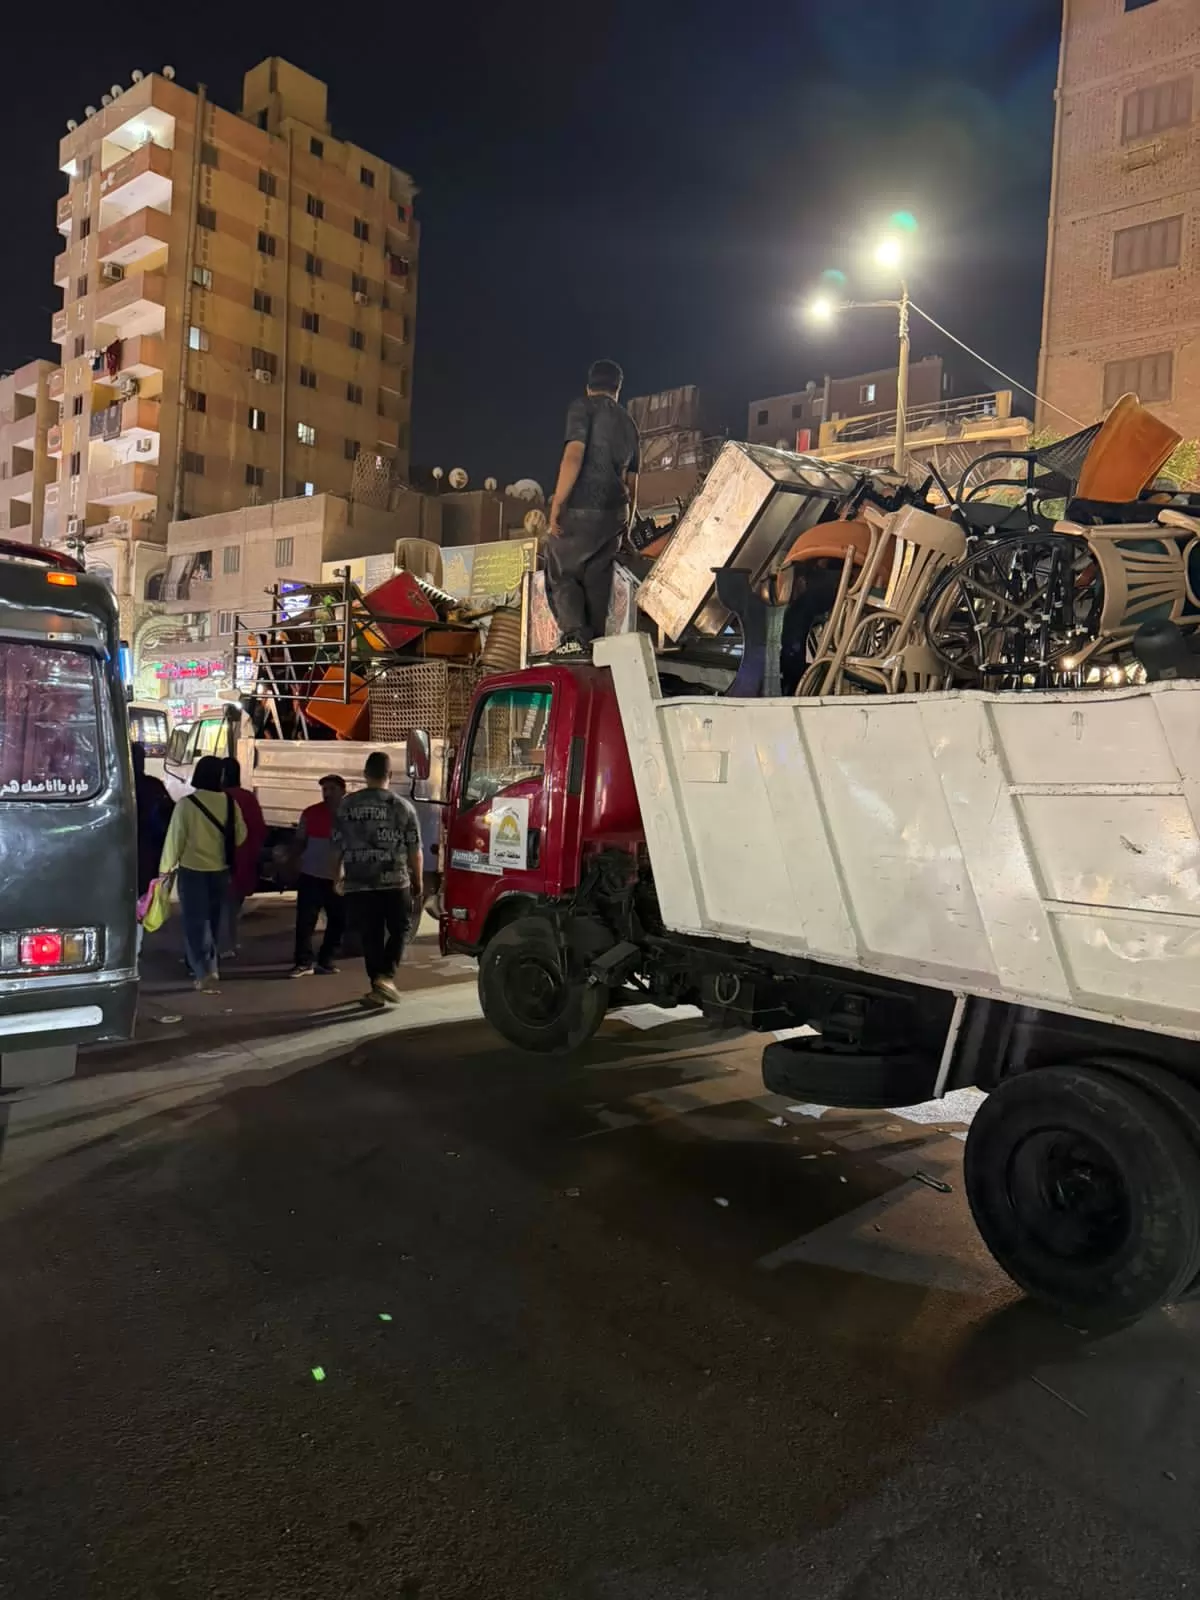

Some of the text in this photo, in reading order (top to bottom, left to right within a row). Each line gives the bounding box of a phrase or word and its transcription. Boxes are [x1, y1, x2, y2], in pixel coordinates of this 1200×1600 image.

[21, 779, 45, 792] عمك
[68, 779, 89, 795] طول
[453, 850, 479, 863] Jumbo
